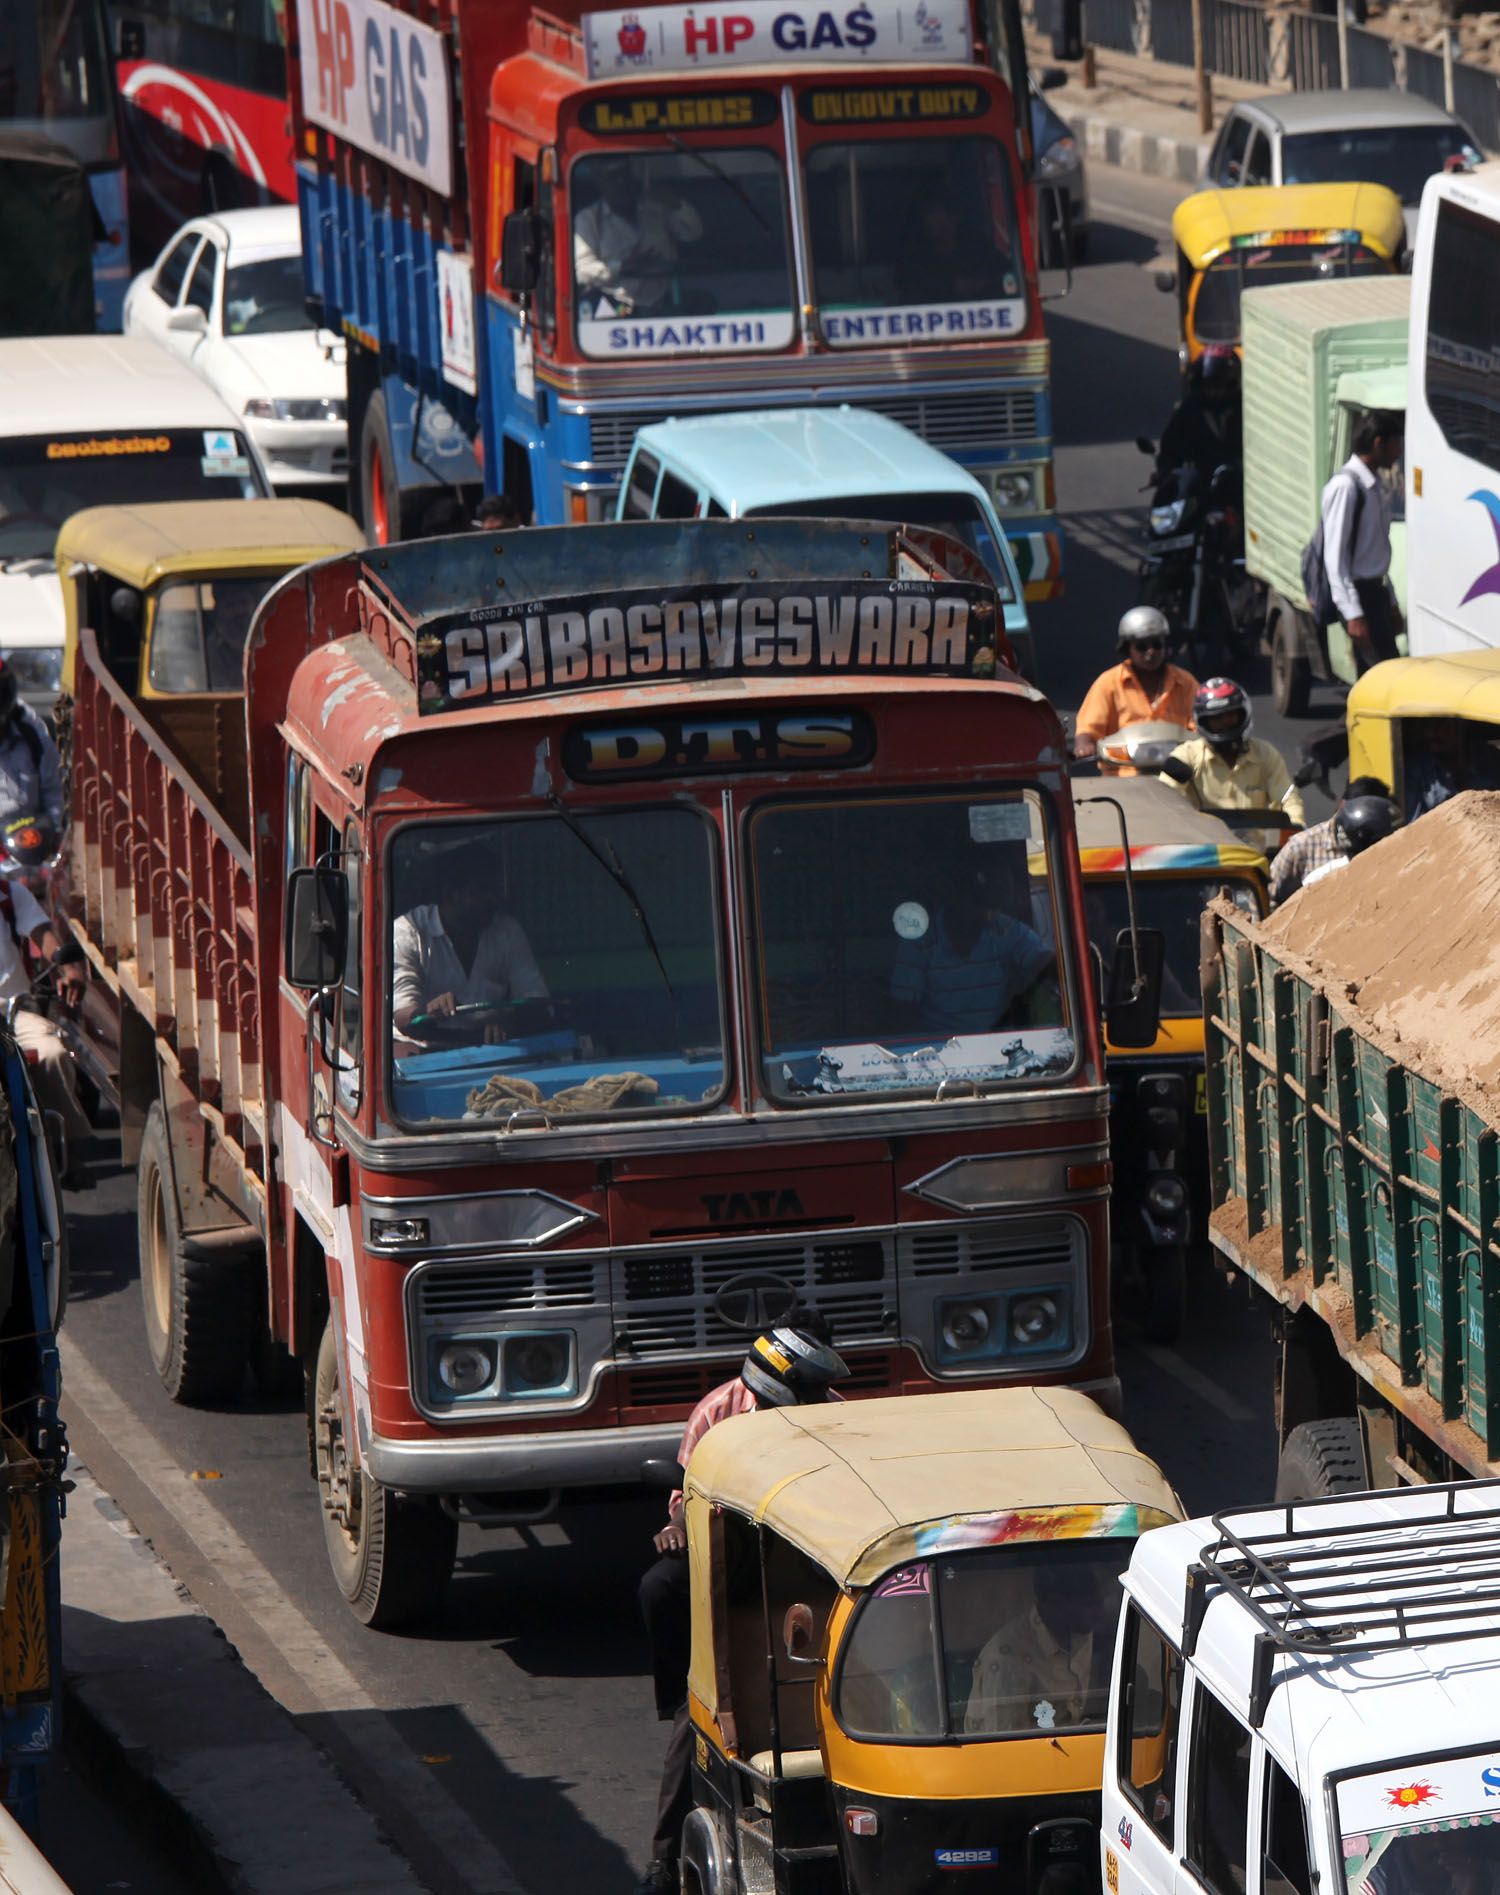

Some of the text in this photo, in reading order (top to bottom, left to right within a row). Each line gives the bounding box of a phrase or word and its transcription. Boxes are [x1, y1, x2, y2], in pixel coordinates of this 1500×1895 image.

[683, 16, 755, 56] HP
[772, 10, 877, 53] GAS
[311, 0, 430, 168] HP GAS
[609, 306, 1013, 349] SHAKTHI ENTERPRISE
[700, 1188, 806, 1223] TATA
[938, 1851, 992, 1863] 4292
